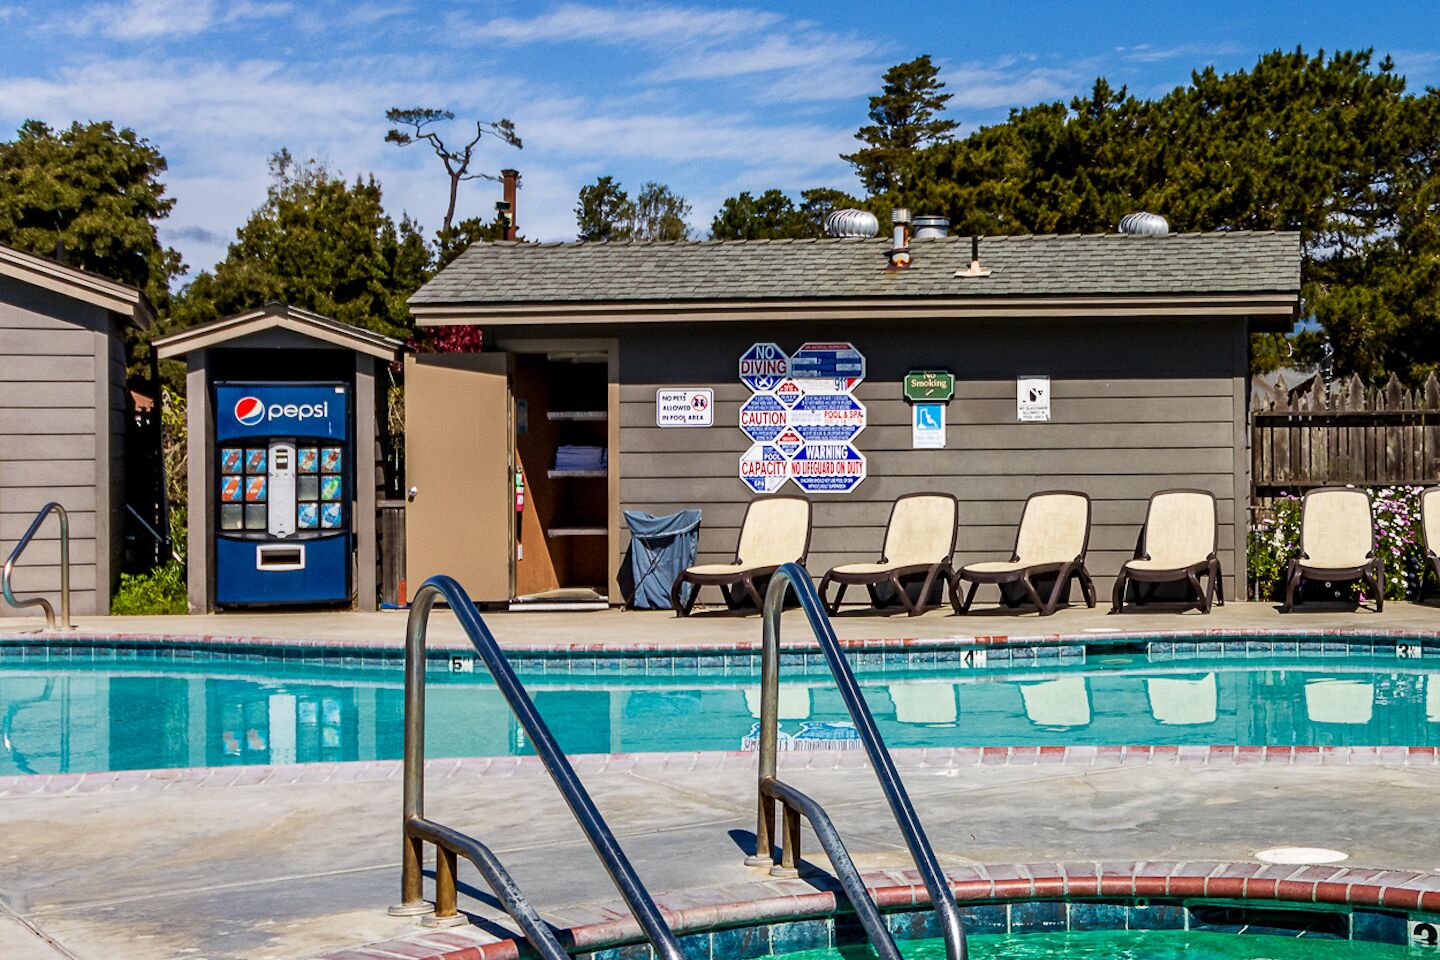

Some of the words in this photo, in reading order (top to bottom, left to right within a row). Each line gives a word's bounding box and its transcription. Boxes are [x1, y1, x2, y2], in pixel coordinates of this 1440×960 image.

[756, 346, 774, 359] NO
[742, 360, 786, 374] DIVING
[911, 380, 947, 389] Smoking
[268, 400, 328, 420] pepsi
[824, 410, 842, 418] POOL
[850, 410, 862, 418] SPA
[742, 412, 786, 424] CAUTION
[806, 446, 848, 460] WARNING
[742, 462, 787, 475] CAPACITY
[792, 462, 800, 474] NO
[802, 462, 834, 474] LIFEGUARD
[836, 462, 845, 474] ON
[848, 462, 863, 474] DUTY
[452, 656, 462, 670] 5
